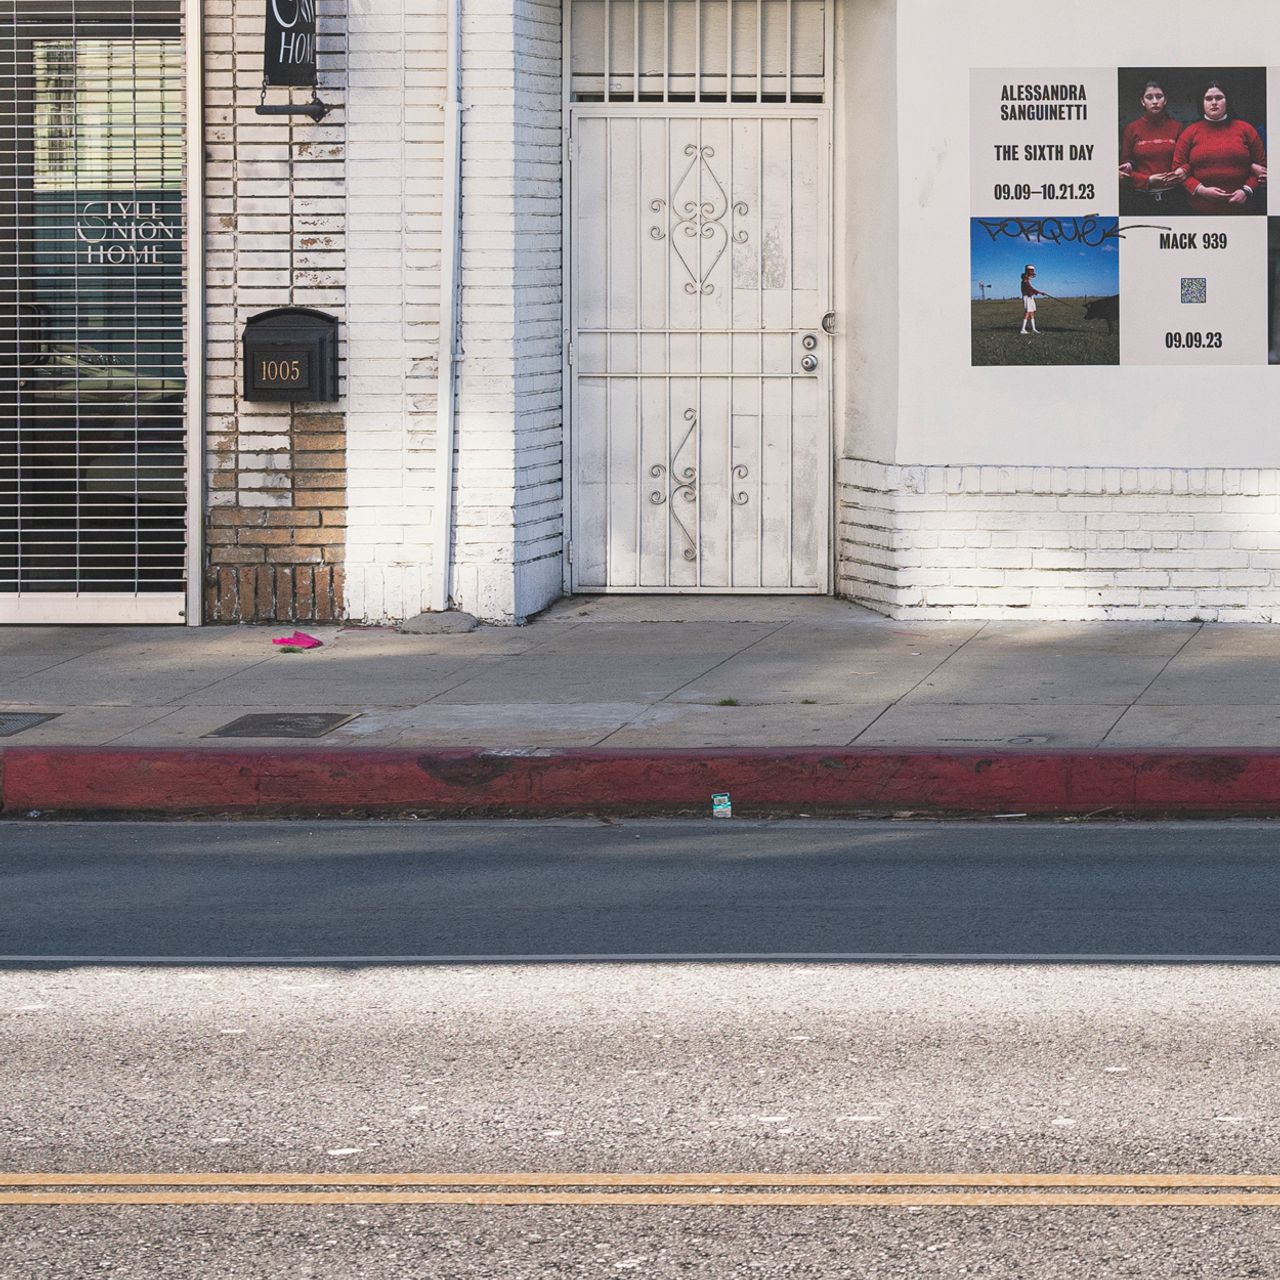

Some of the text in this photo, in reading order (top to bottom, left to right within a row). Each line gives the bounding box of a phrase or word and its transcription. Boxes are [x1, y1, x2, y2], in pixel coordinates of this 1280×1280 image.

[1000, 84, 1087, 102] ALESSANDRA
[1000, 104, 1088, 121] SANGUINETTI
[993, 144, 1095, 161] THE SIXTH DAY
[1159, 232, 1228, 250] MACK 939
[87, 245, 164, 264] HOME
[1165, 331, 1223, 349] 09.09.23
[261, 360, 300, 381] 1005
